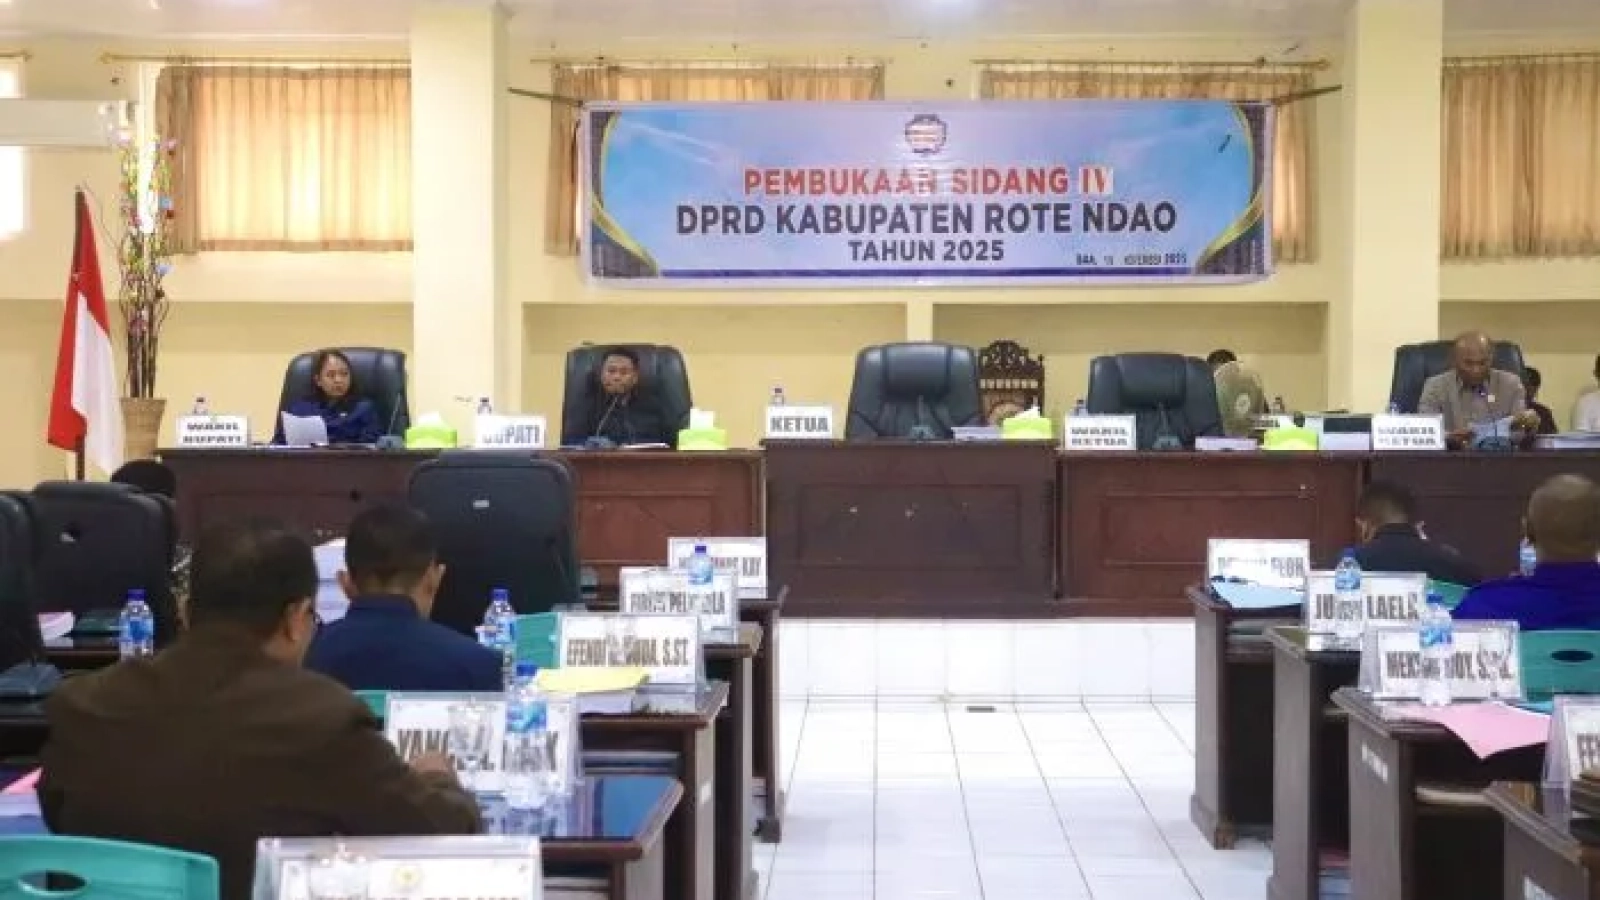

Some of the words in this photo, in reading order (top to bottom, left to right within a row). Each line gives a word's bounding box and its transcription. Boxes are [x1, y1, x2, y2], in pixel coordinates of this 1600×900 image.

[744, 167, 936, 195] PEMBUKAAN
[952, 167, 1069, 195] SIDANG
[676, 204, 766, 235] DPRD
[776, 202, 973, 234] KABUPATEN
[984, 202, 1073, 234] ROTE
[1082, 200, 1178, 233] NDAO
[848, 239, 936, 261] TAHUN
[942, 239, 1005, 261] 2025
[770, 416, 830, 432] KETUA
